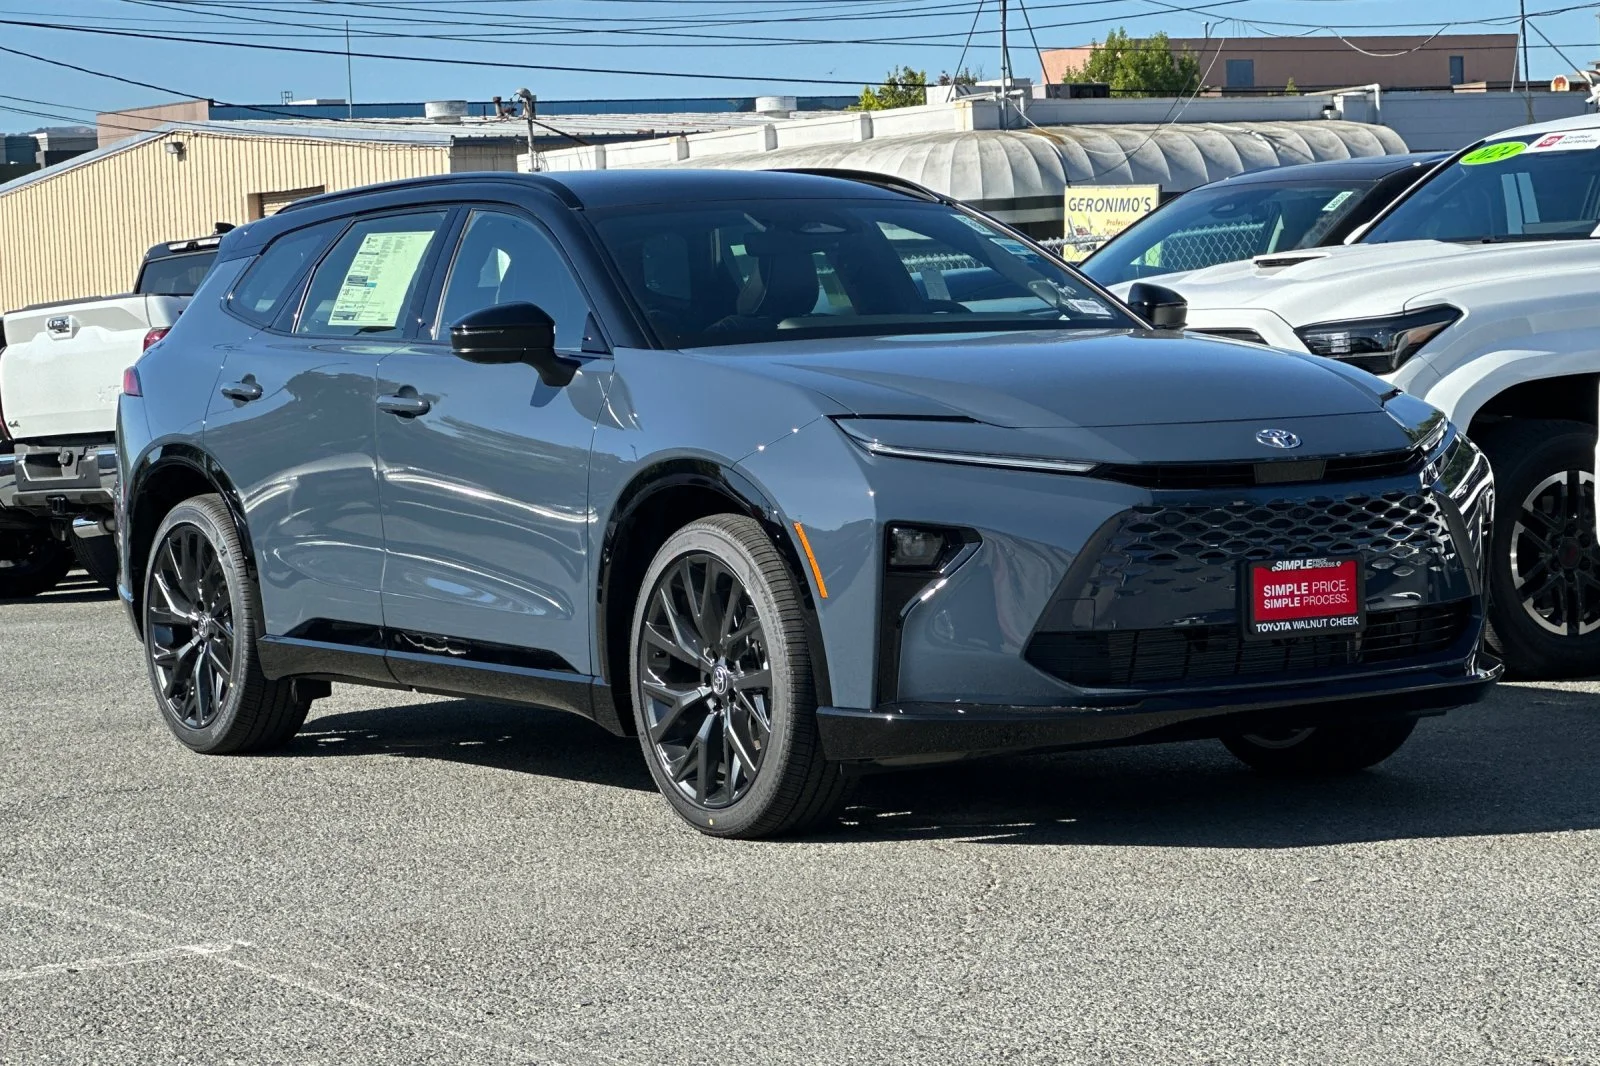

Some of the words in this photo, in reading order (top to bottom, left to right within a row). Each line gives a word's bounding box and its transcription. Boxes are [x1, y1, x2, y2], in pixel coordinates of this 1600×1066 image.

[1068, 197, 1151, 212] GERONIMO'S
[1276, 560, 1313, 571] SIMPLE
[1263, 583, 1309, 597] SIMPLE
[1312, 580, 1349, 593] PRICE.
[1264, 597, 1301, 609] SIMPLE
[1303, 593, 1350, 606] PROCESS.
[1256, 621, 1291, 632] TOYOTA
[1292, 618, 1328, 630] WALNUT
[1329, 616, 1359, 627] CHEEK
